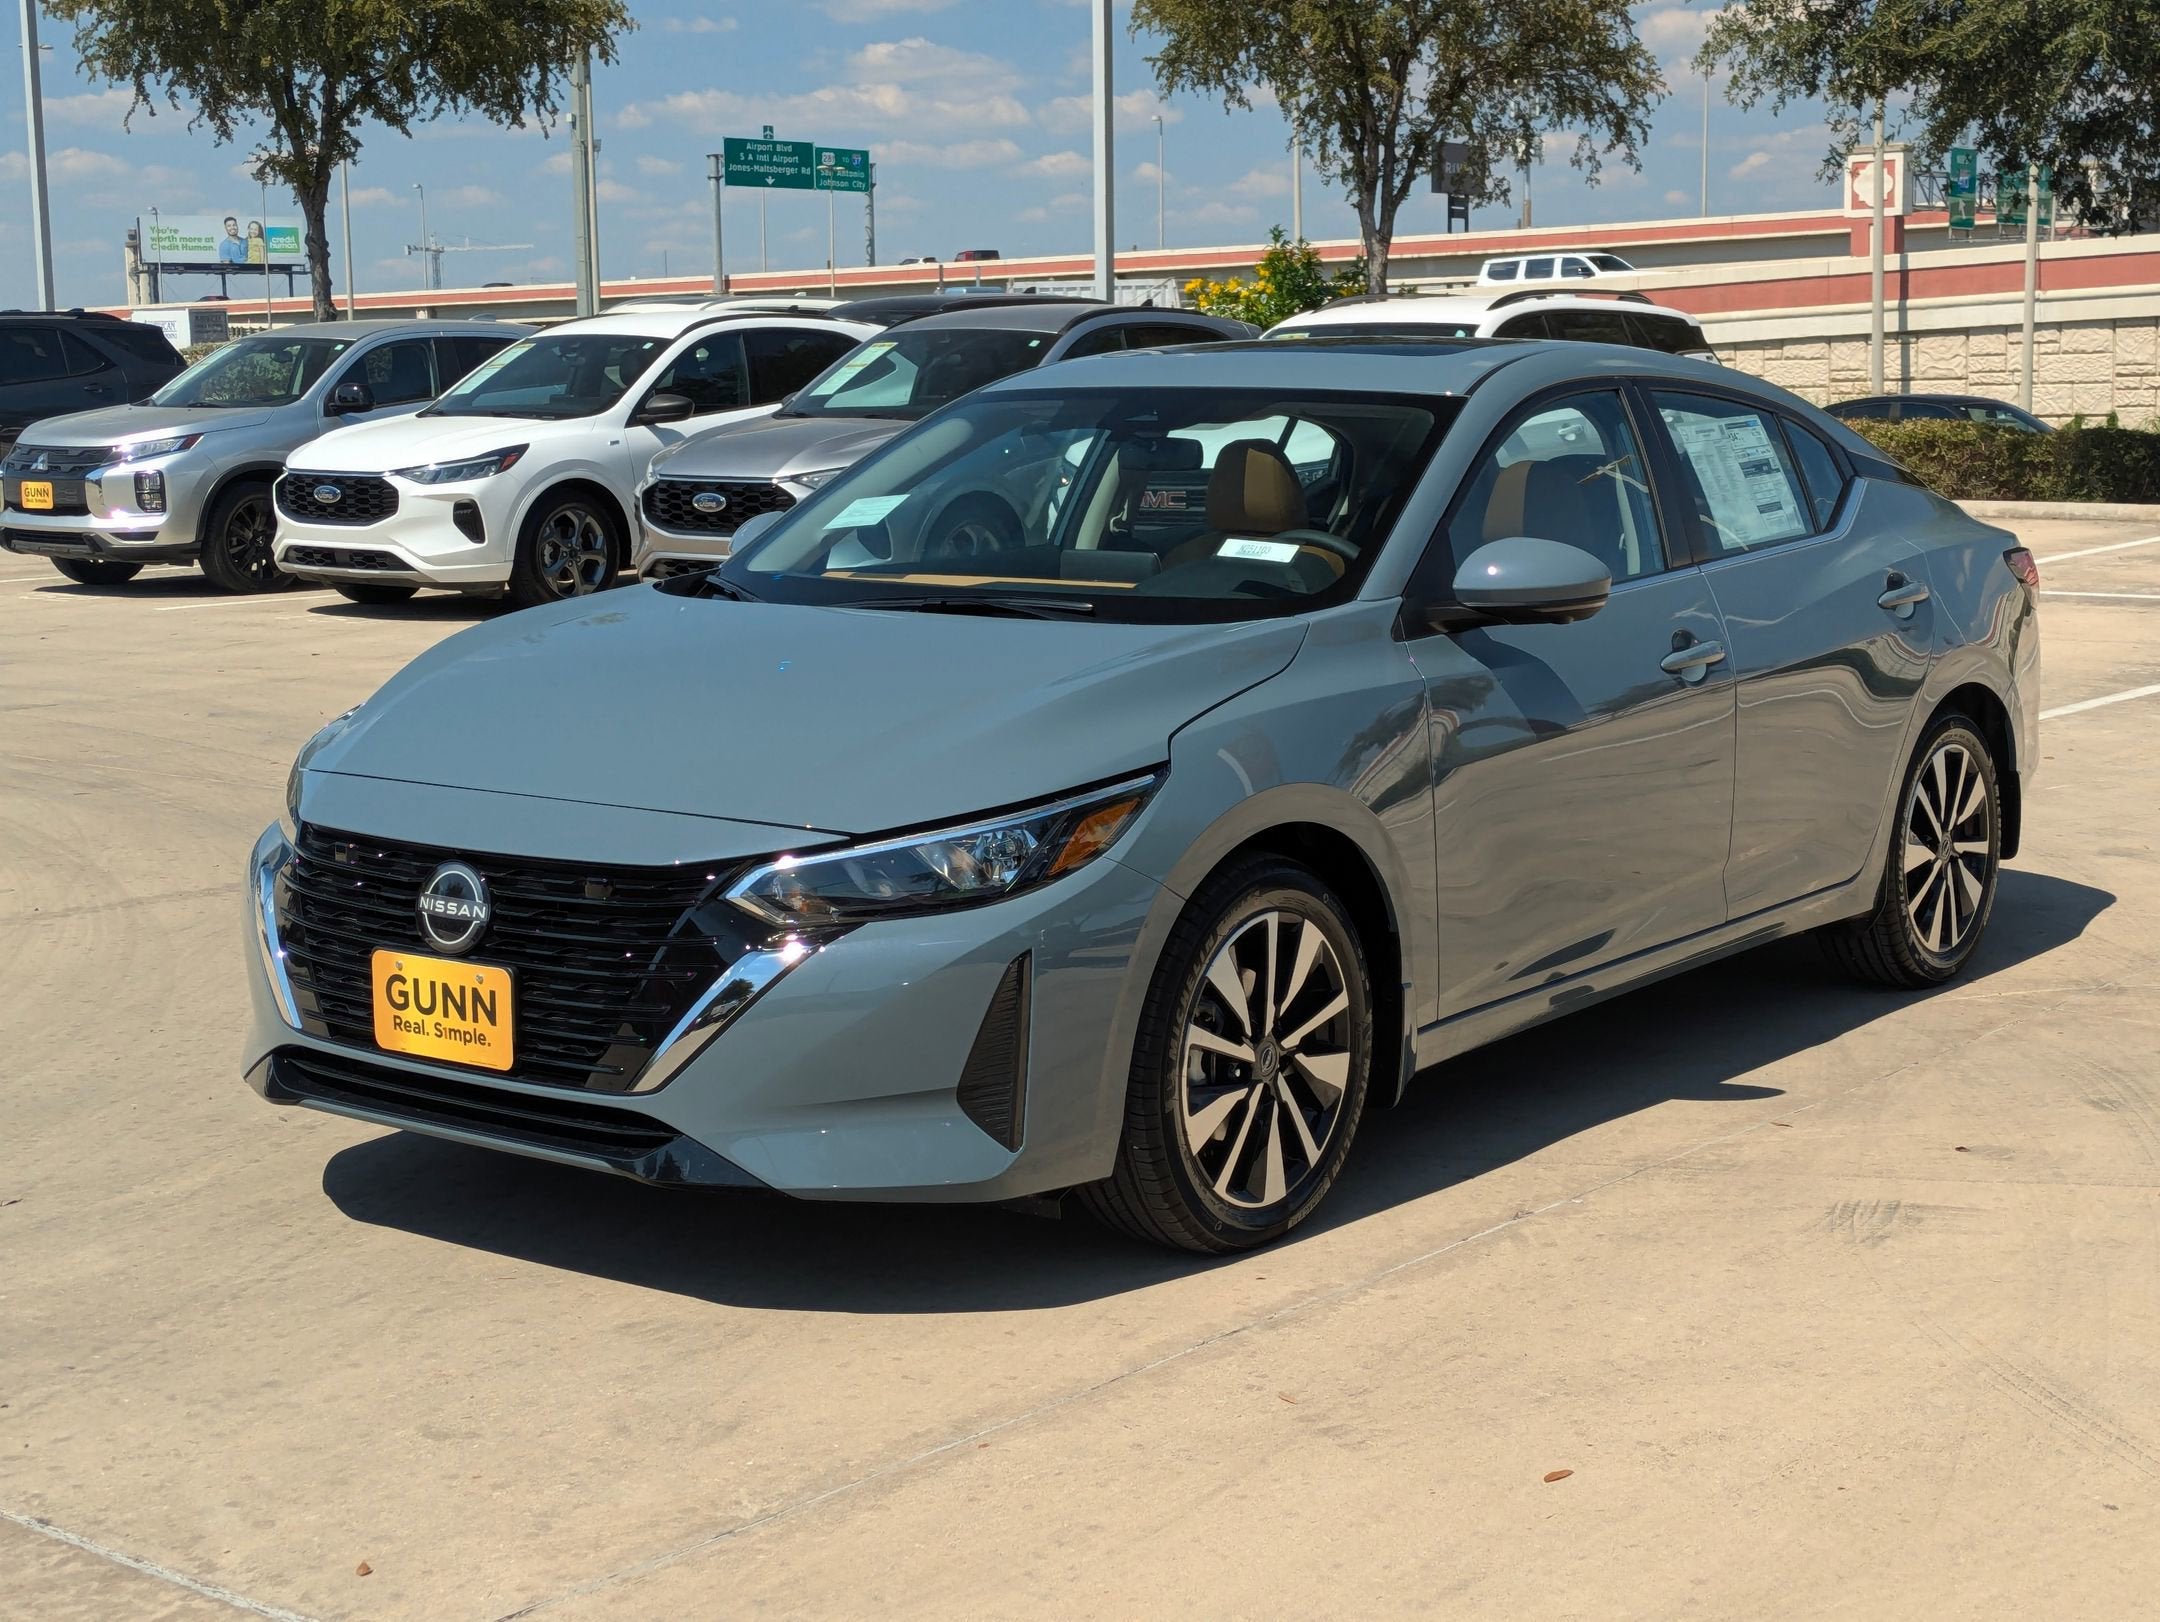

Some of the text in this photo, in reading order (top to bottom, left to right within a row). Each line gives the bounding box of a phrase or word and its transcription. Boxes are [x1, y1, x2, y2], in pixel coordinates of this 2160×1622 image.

[746, 143, 792, 152] Airport Blvd
[740, 153, 745, 161] S
[756, 154, 770, 162] Intl
[772, 154, 799, 164] Airport
[728, 163, 811, 176] Jones-Maltsberger Rd
[852, 180, 866, 190] City
[150, 235, 178, 243] worth
[150, 243, 179, 251] Credit
[25, 487, 49, 499] GUNN
[419, 895, 486, 919] NISSAN
[385, 973, 497, 1027] GUNN
[393, 1014, 430, 1036] Real.
